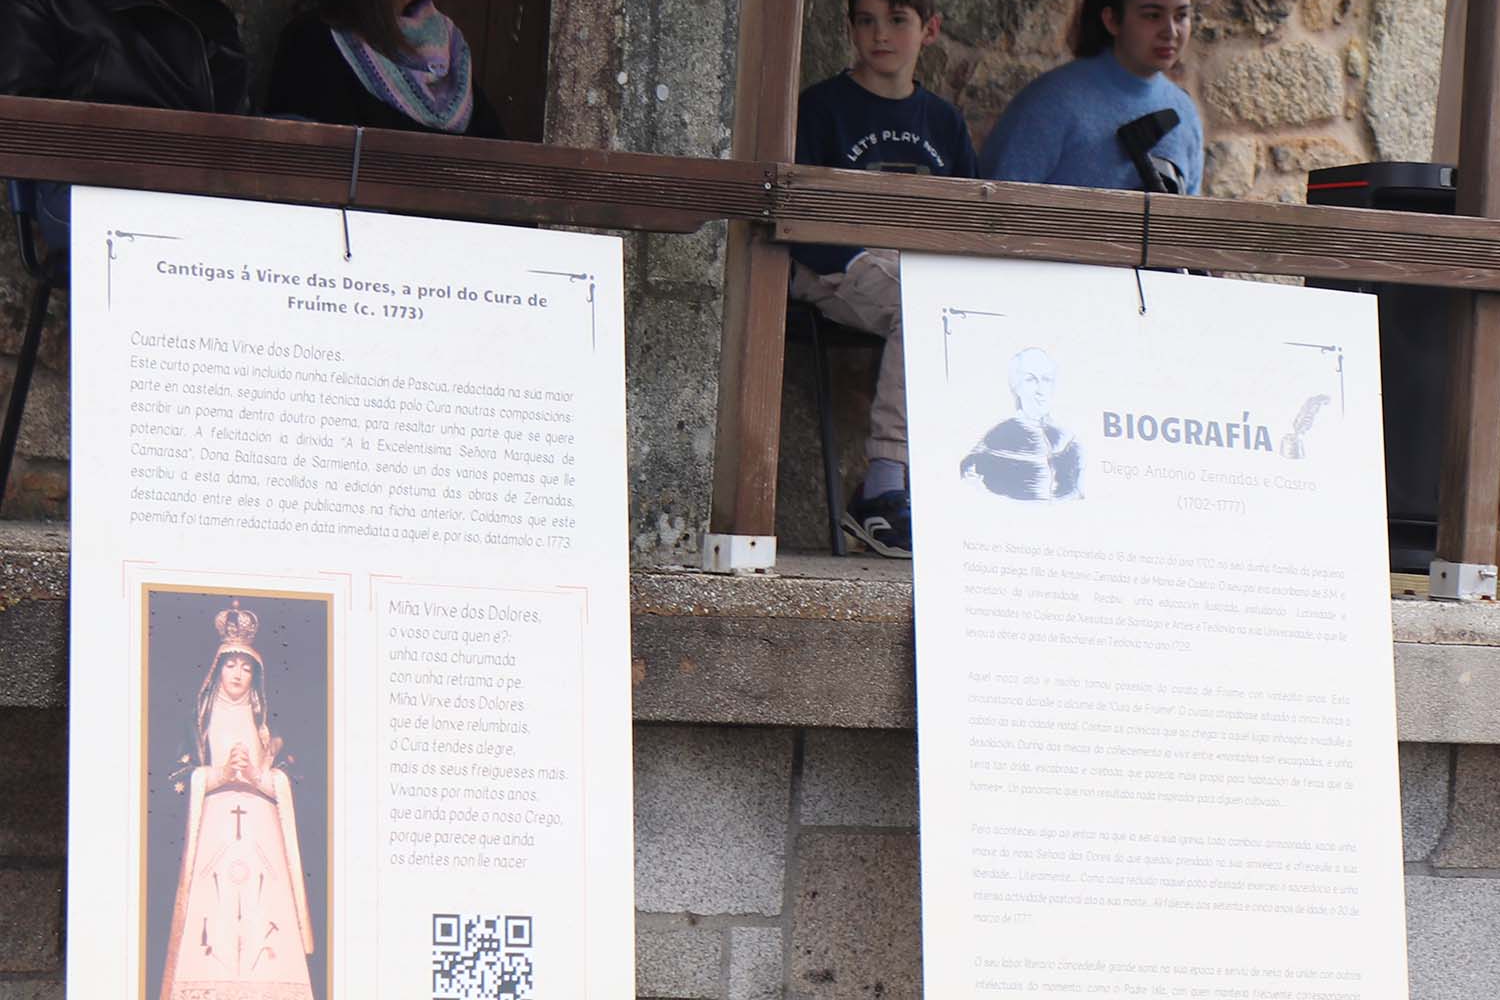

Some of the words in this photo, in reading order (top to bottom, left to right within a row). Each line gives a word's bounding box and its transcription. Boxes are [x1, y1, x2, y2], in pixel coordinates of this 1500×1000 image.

[846, 134, 878, 162] LET'S
[882, 130, 921, 144] PLAY
[155, 259, 235, 282] Cantigas
[240, 263, 250, 281] á
[255, 267, 300, 286] Virxe
[305, 272, 336, 289] das
[341, 276, 396, 296] Dores,
[401, 284, 411, 295] a
[416, 284, 451, 299] prol
[456, 285, 478, 302] do
[482, 288, 522, 305] Cura
[526, 292, 547, 308] de
[287, 294, 347, 314] Fruíme
[353, 300, 375, 316] (c.
[381, 303, 424, 320] 1773)
[1102, 410, 1273, 452] BIOGRAFÍA
[1101, 461, 1139, 480] Diego
[1144, 464, 1195, 480] Antonio
